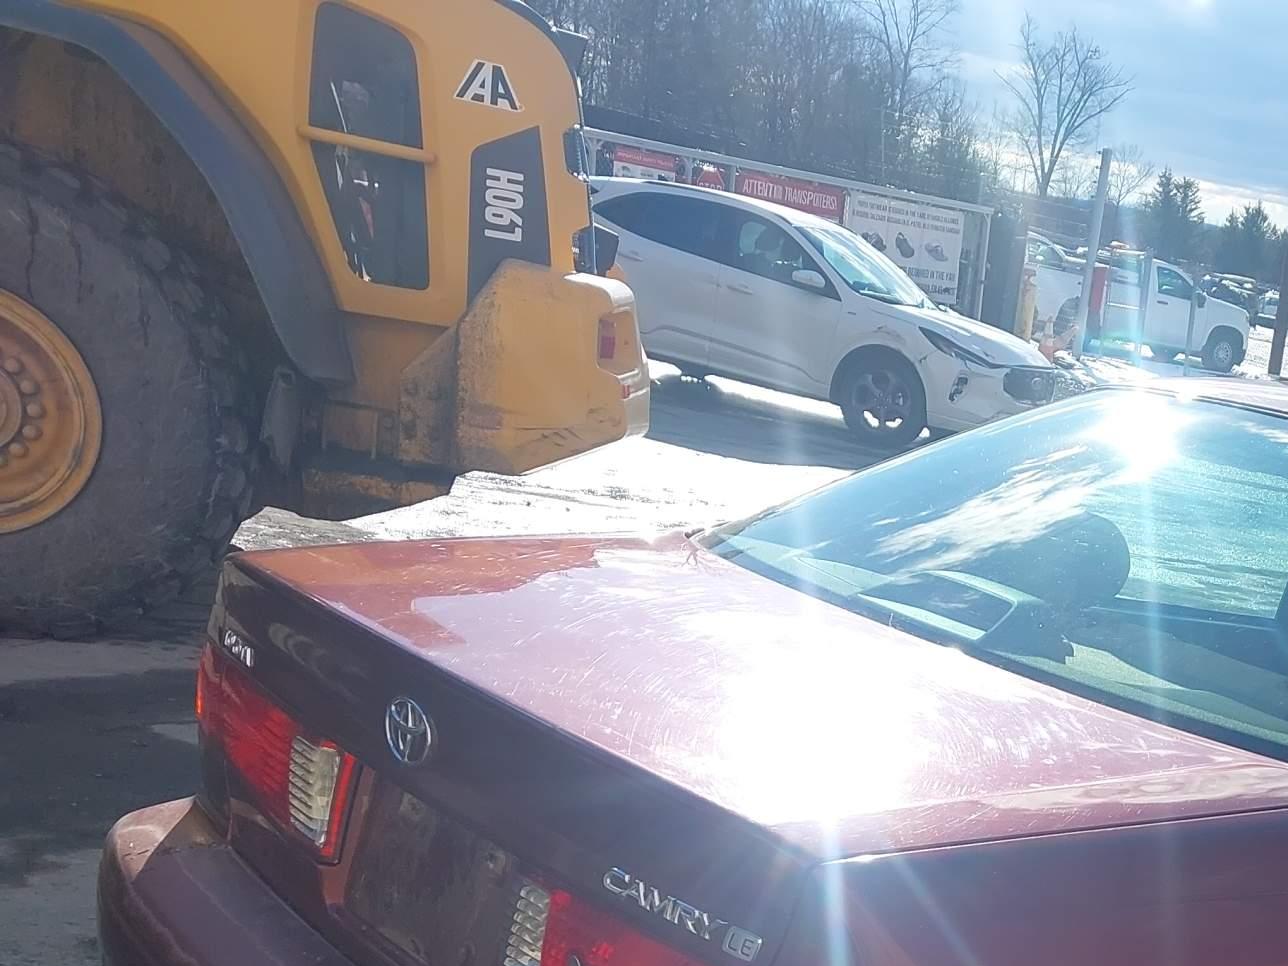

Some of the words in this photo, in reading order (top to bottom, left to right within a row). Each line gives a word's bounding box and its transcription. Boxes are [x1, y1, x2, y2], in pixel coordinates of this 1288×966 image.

[484, 167, 525, 242] L90H
[743, 179, 783, 200] ATTENTI
[784, 186, 838, 210] TRANSPOTERS!
[603, 866, 728, 941] CAMRY
[725, 930, 757, 958] LE
